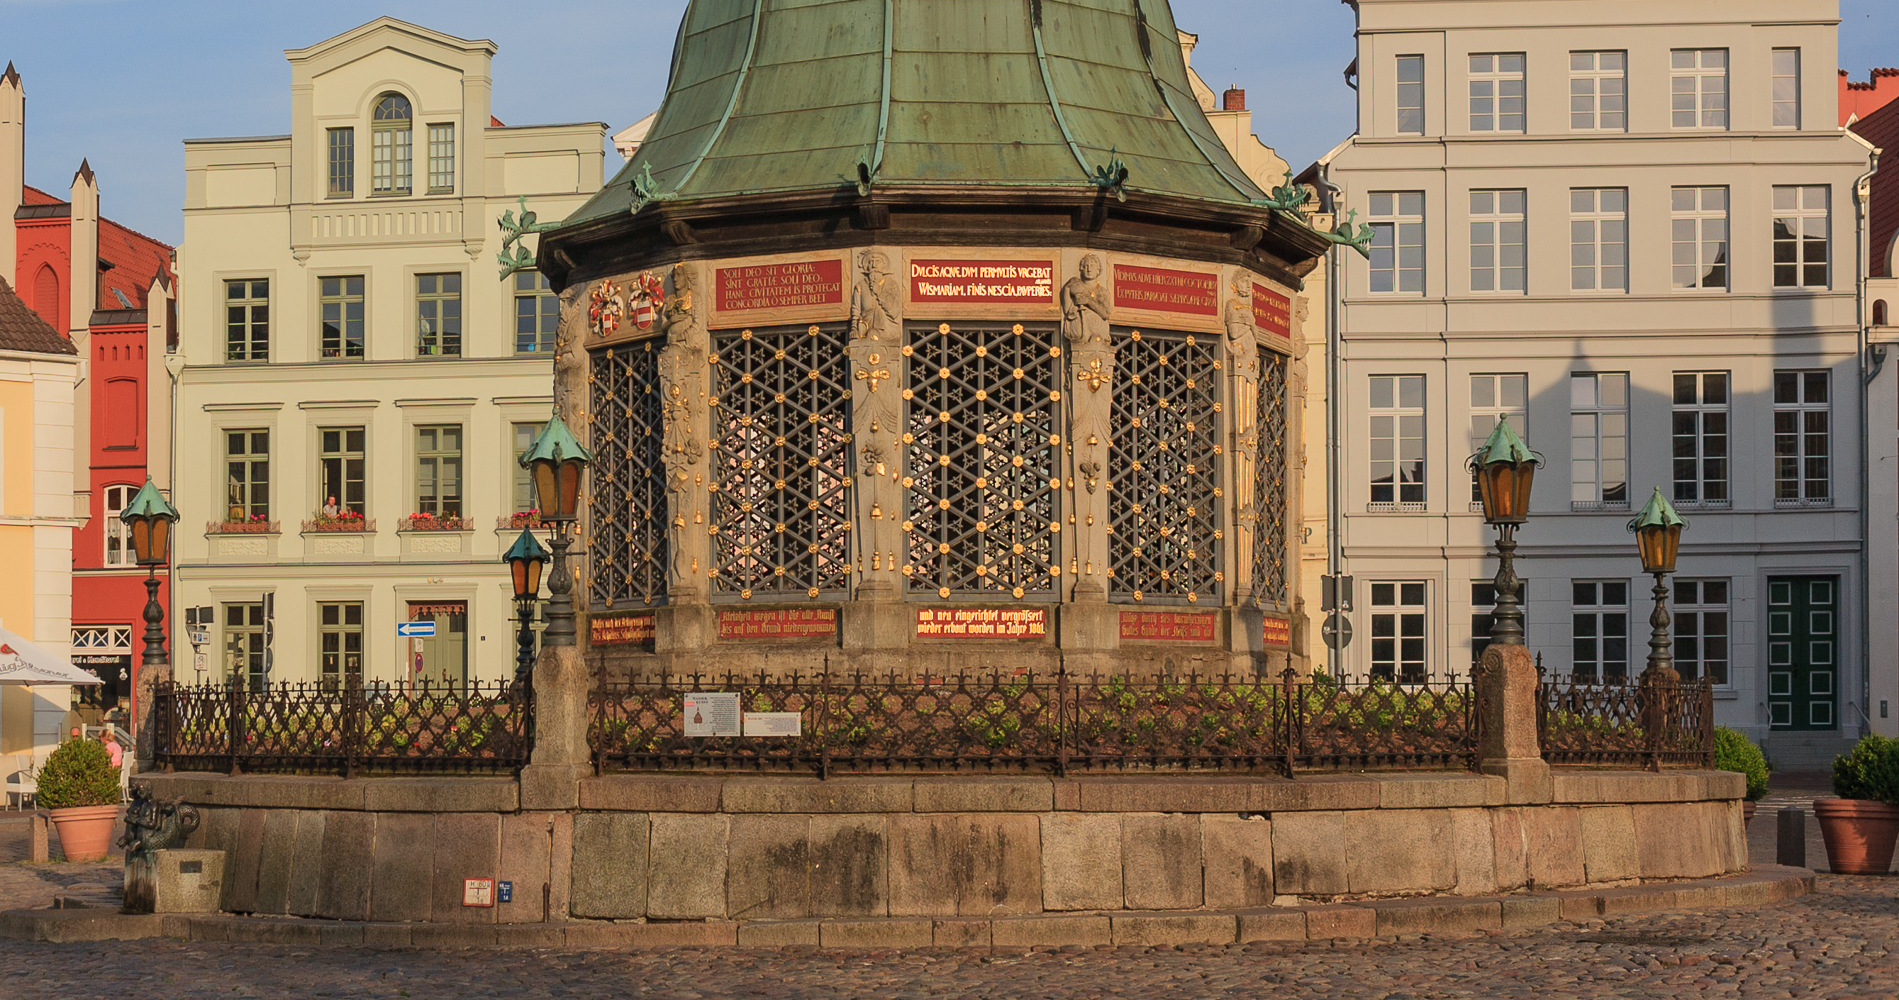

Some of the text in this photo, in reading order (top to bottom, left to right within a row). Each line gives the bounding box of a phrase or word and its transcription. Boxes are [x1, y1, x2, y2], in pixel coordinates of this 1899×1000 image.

[746, 268, 761, 277] DEO
[726, 290, 746, 299] HANC
[803, 282, 840, 294] PROTEGAT
[809, 294, 826, 303] BEET
[920, 609, 933, 620] und
[938, 611, 951, 620] neu
[918, 622, 942, 633] wieder
[944, 622, 967, 633] erbaut
[968, 622, 994, 633] worden
[997, 622, 1005, 633] im
[1007, 622, 1027, 636] Jahre
